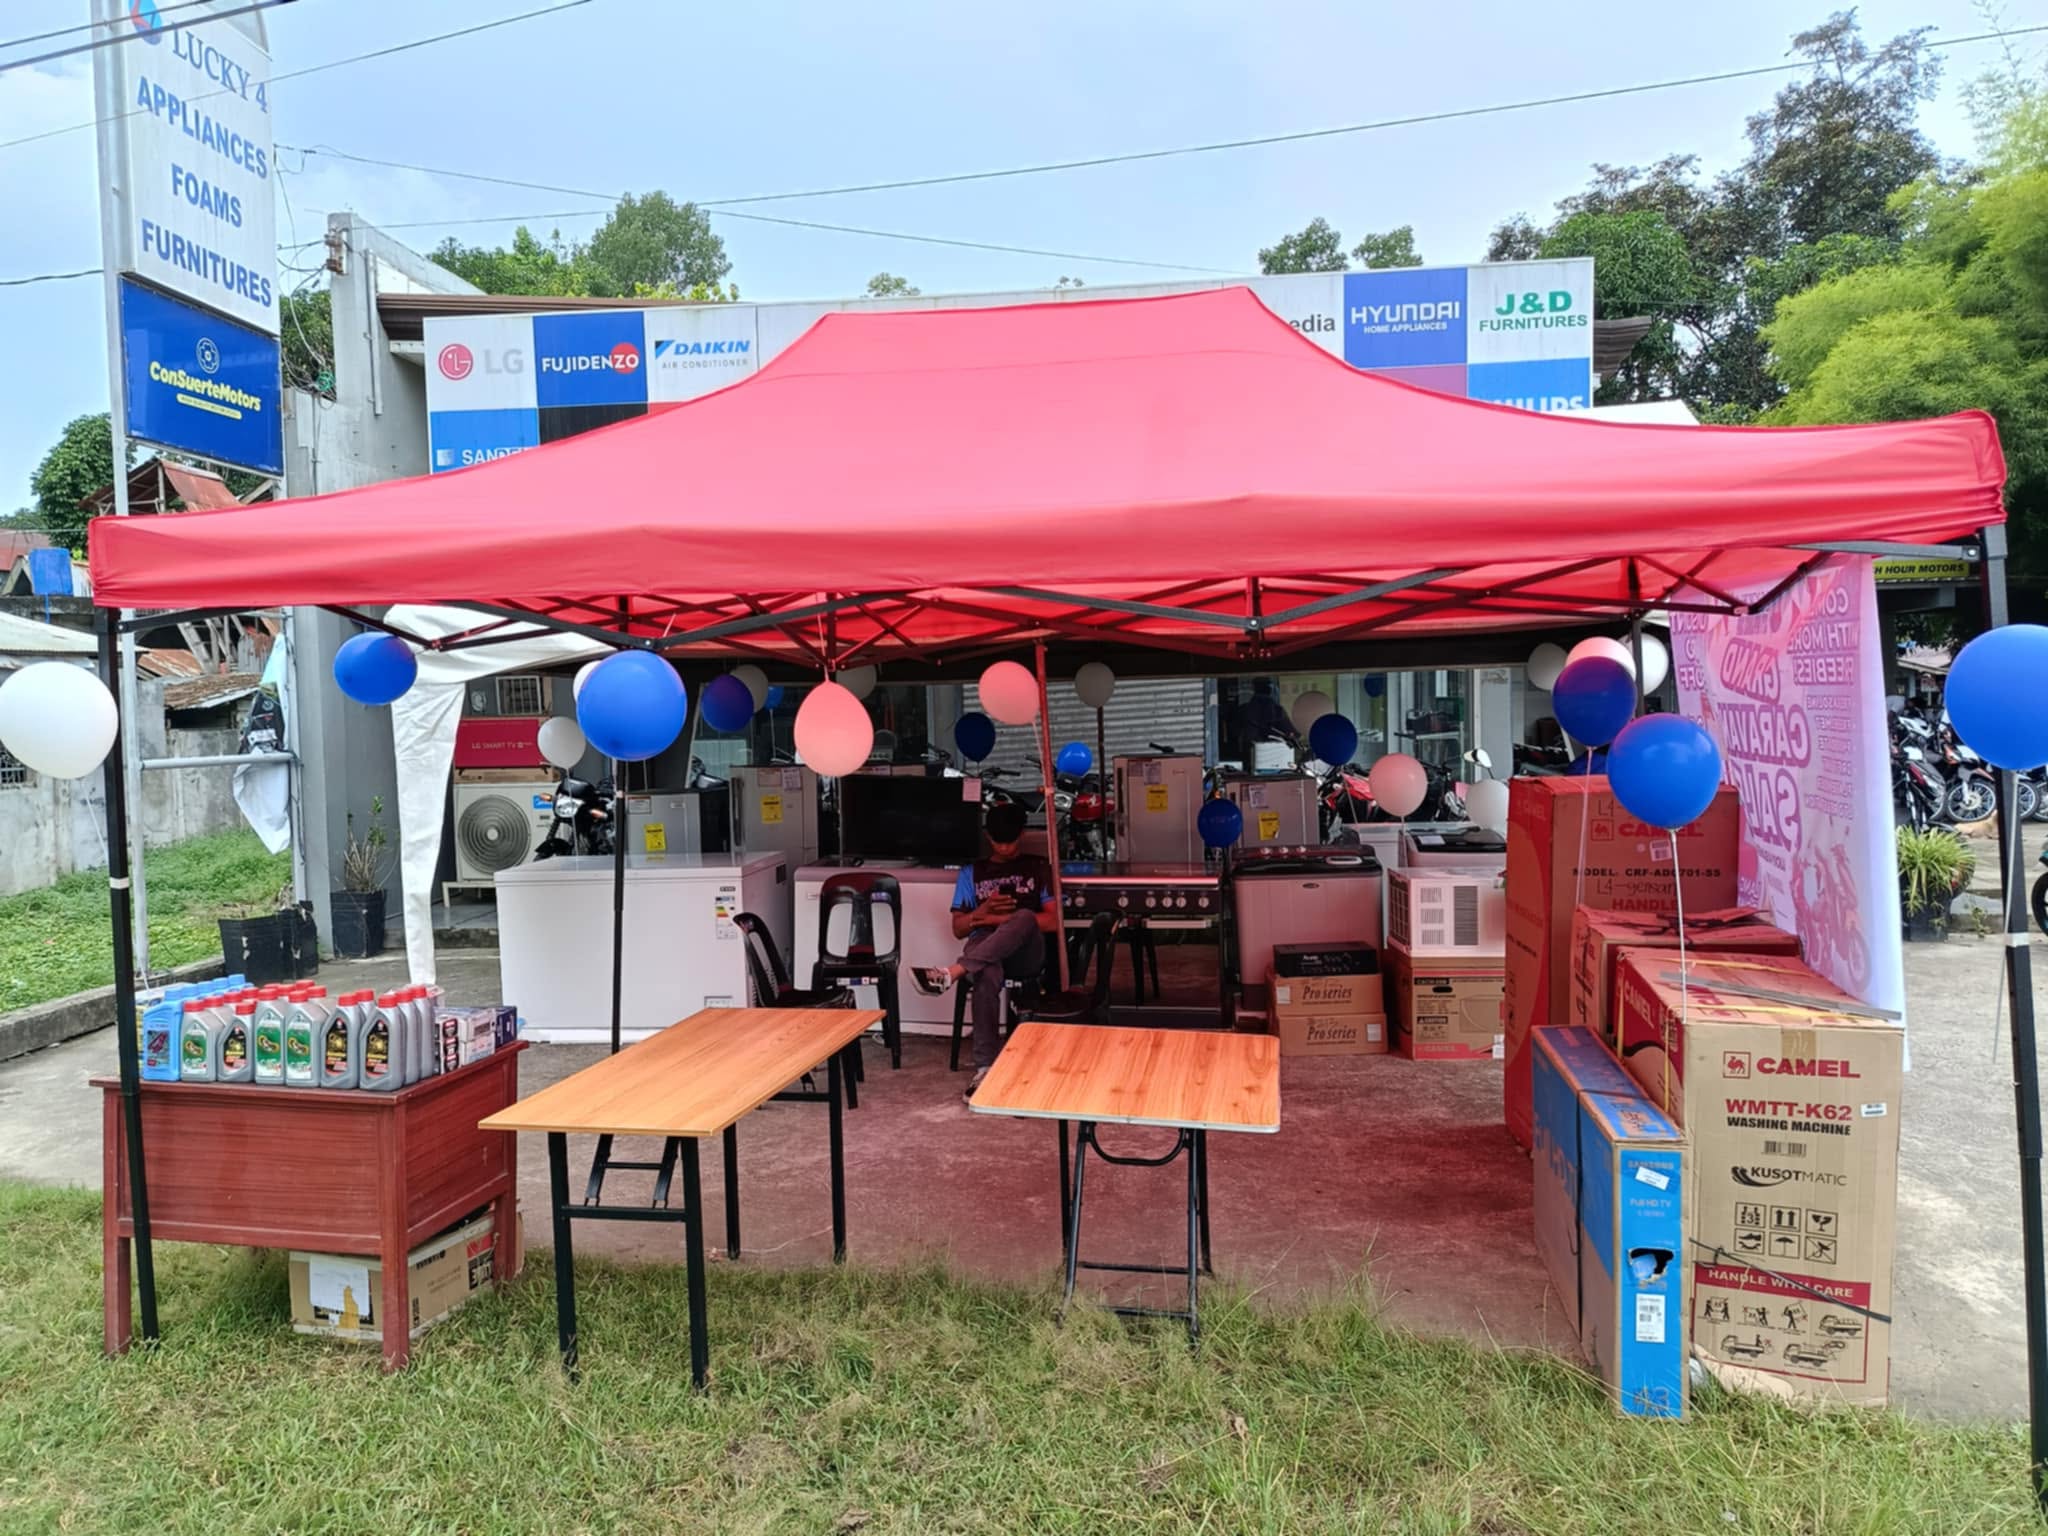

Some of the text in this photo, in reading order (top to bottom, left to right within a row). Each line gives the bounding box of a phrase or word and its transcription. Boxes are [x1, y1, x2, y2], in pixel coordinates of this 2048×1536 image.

[171, 22, 269, 114] LUCKY 4
[136, 75, 268, 180] APPLIANCES
[171, 162, 243, 229] FOAMS
[141, 218, 272, 309] FURNITURES
[1351, 301, 1461, 325] HYUNDAI
[1495, 290, 1572, 316] J&D
[1288, 313, 1336, 334] edia
[1364, 322, 1448, 334] HOME APPLIANCES
[1479, 314, 1588, 333] FURNITURES
[673, 340, 751, 356] DAIKIN
[483, 347, 525, 375] LG
[541, 353, 640, 374] FUJIDENZO
[661, 357, 749, 370] AIR CONDITIONER
[149, 361, 262, 412] ConSuerteMotors
[1885, 565, 1916, 574] HOUR
[1918, 563, 1965, 574] MOTORS
[1756, 1057, 1861, 1079] CAMEL
[1725, 1098, 1853, 1121] WMTT-K62
[1727, 1116, 1852, 1136] WASHING MACHINE
[1750, 1165, 1848, 1187] KUSOTMATIC
[1708, 1269, 1767, 1287] HANDLE
[1813, 1283, 1855, 1299] CARE
